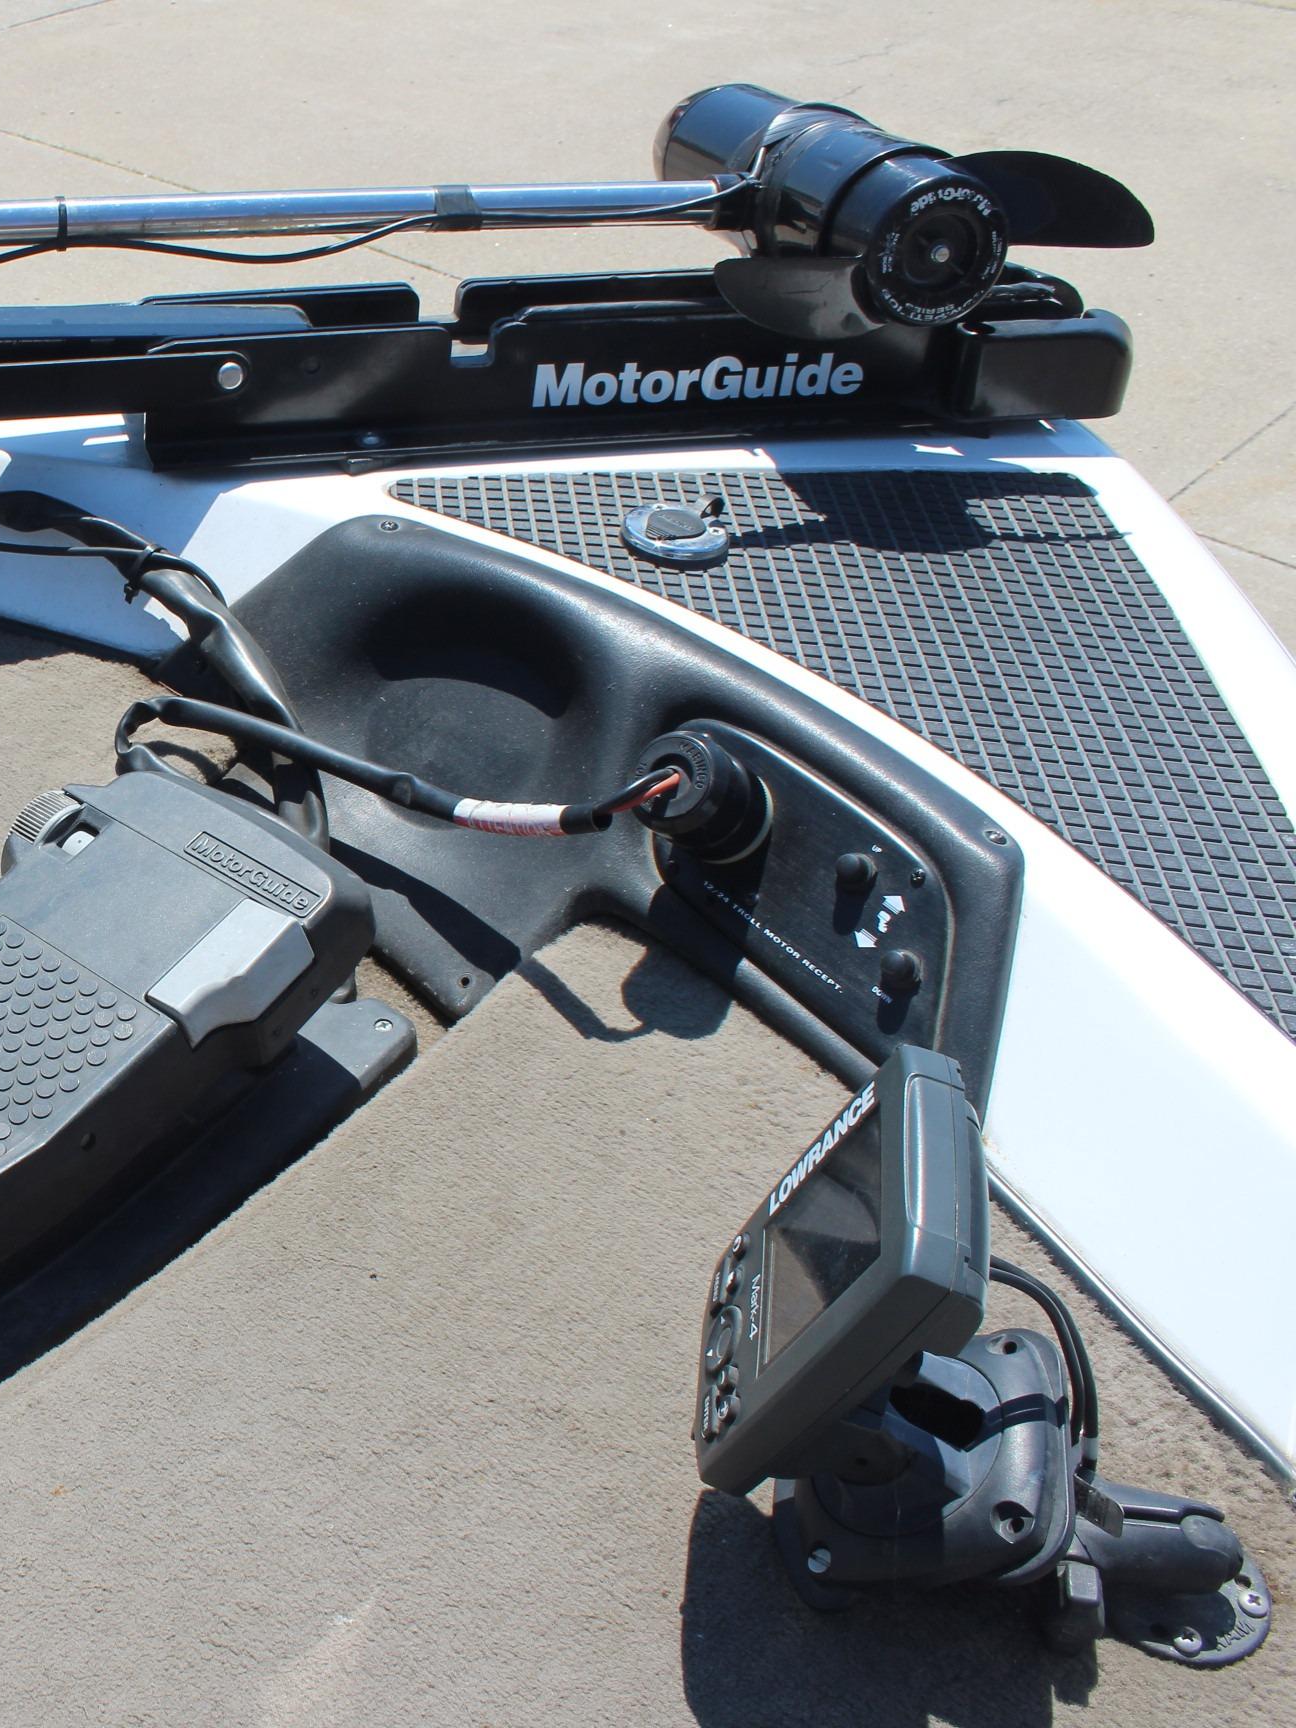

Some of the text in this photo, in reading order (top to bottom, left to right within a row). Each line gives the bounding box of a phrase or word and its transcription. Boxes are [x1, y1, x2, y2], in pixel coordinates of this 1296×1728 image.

[532, 353, 864, 408] MotorGuide
[192, 838, 309, 910] MotorGuide
[871, 845, 882, 853] UP
[732, 903, 761, 929] TROLL
[764, 928, 801, 959] MOTOR
[802, 959, 844, 993] RECEPT.
[769, 1081, 875, 1217] LOWRANCE
